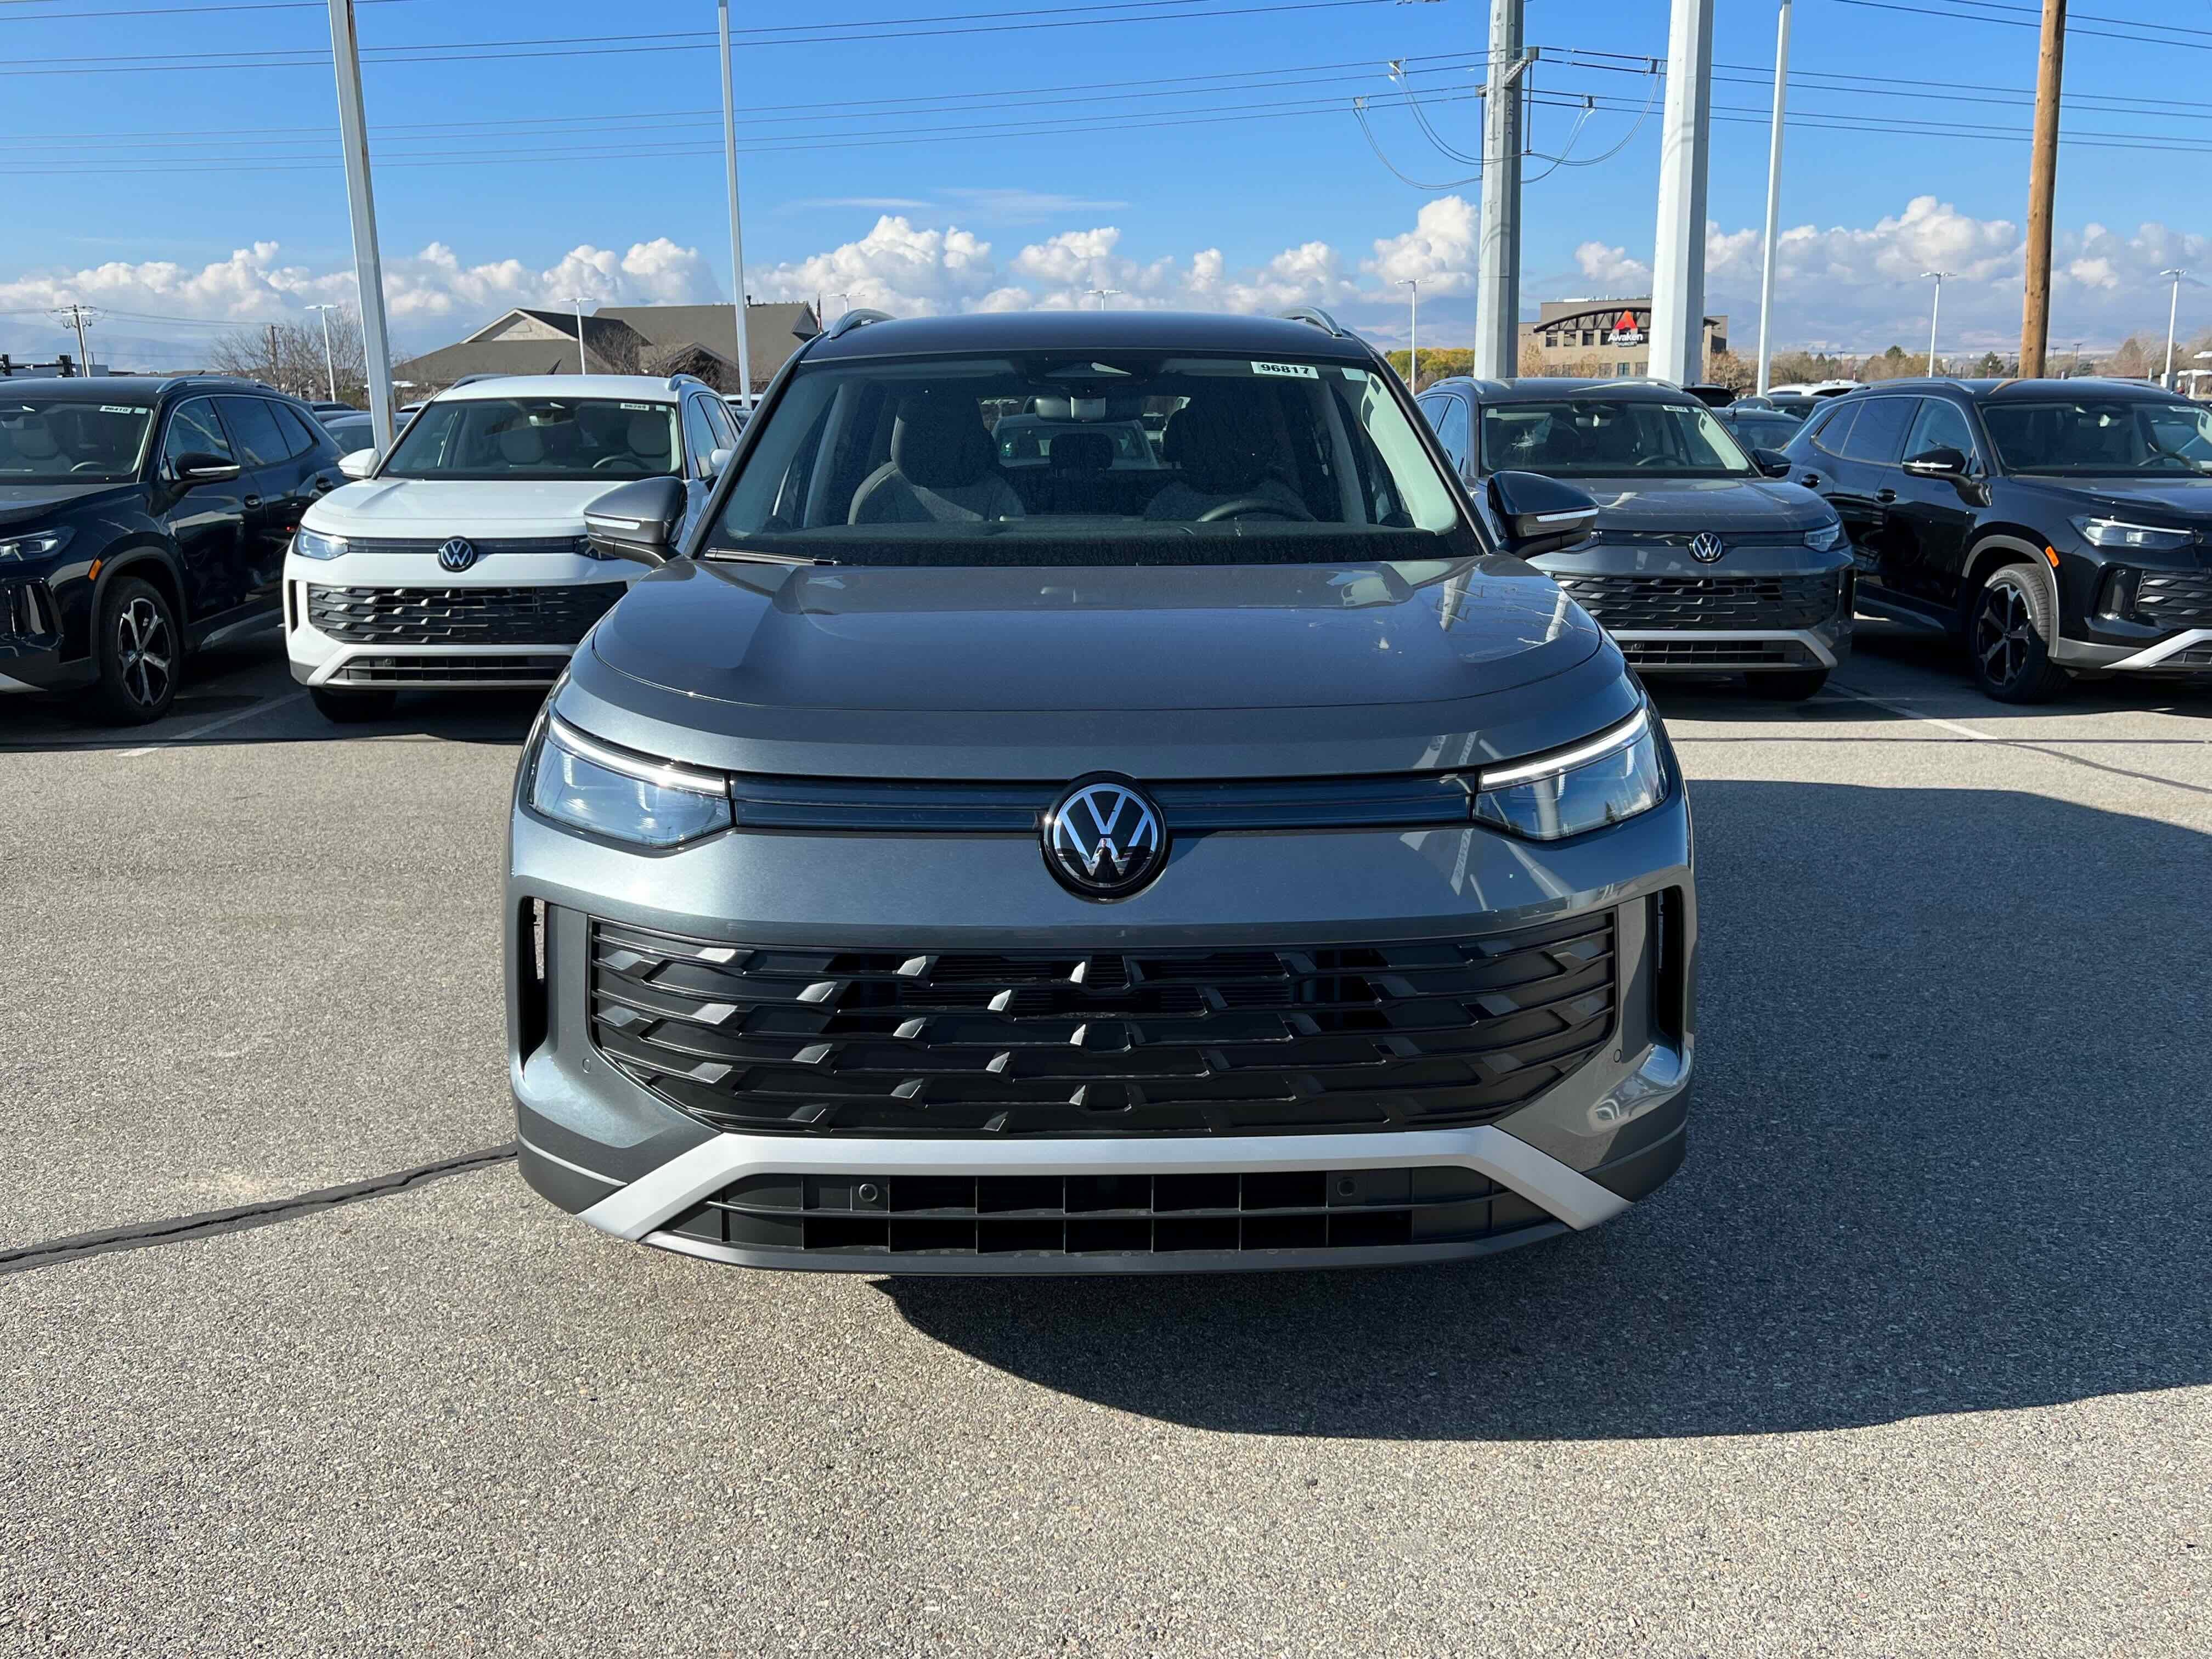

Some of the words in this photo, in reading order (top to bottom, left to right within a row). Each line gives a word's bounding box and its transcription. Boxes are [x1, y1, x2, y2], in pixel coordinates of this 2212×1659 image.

[1607, 332, 1643, 342] Awaken
[1261, 364, 1309, 374] 96817
[441, 539, 473, 569] VW
[1053, 783, 1158, 887] VW
